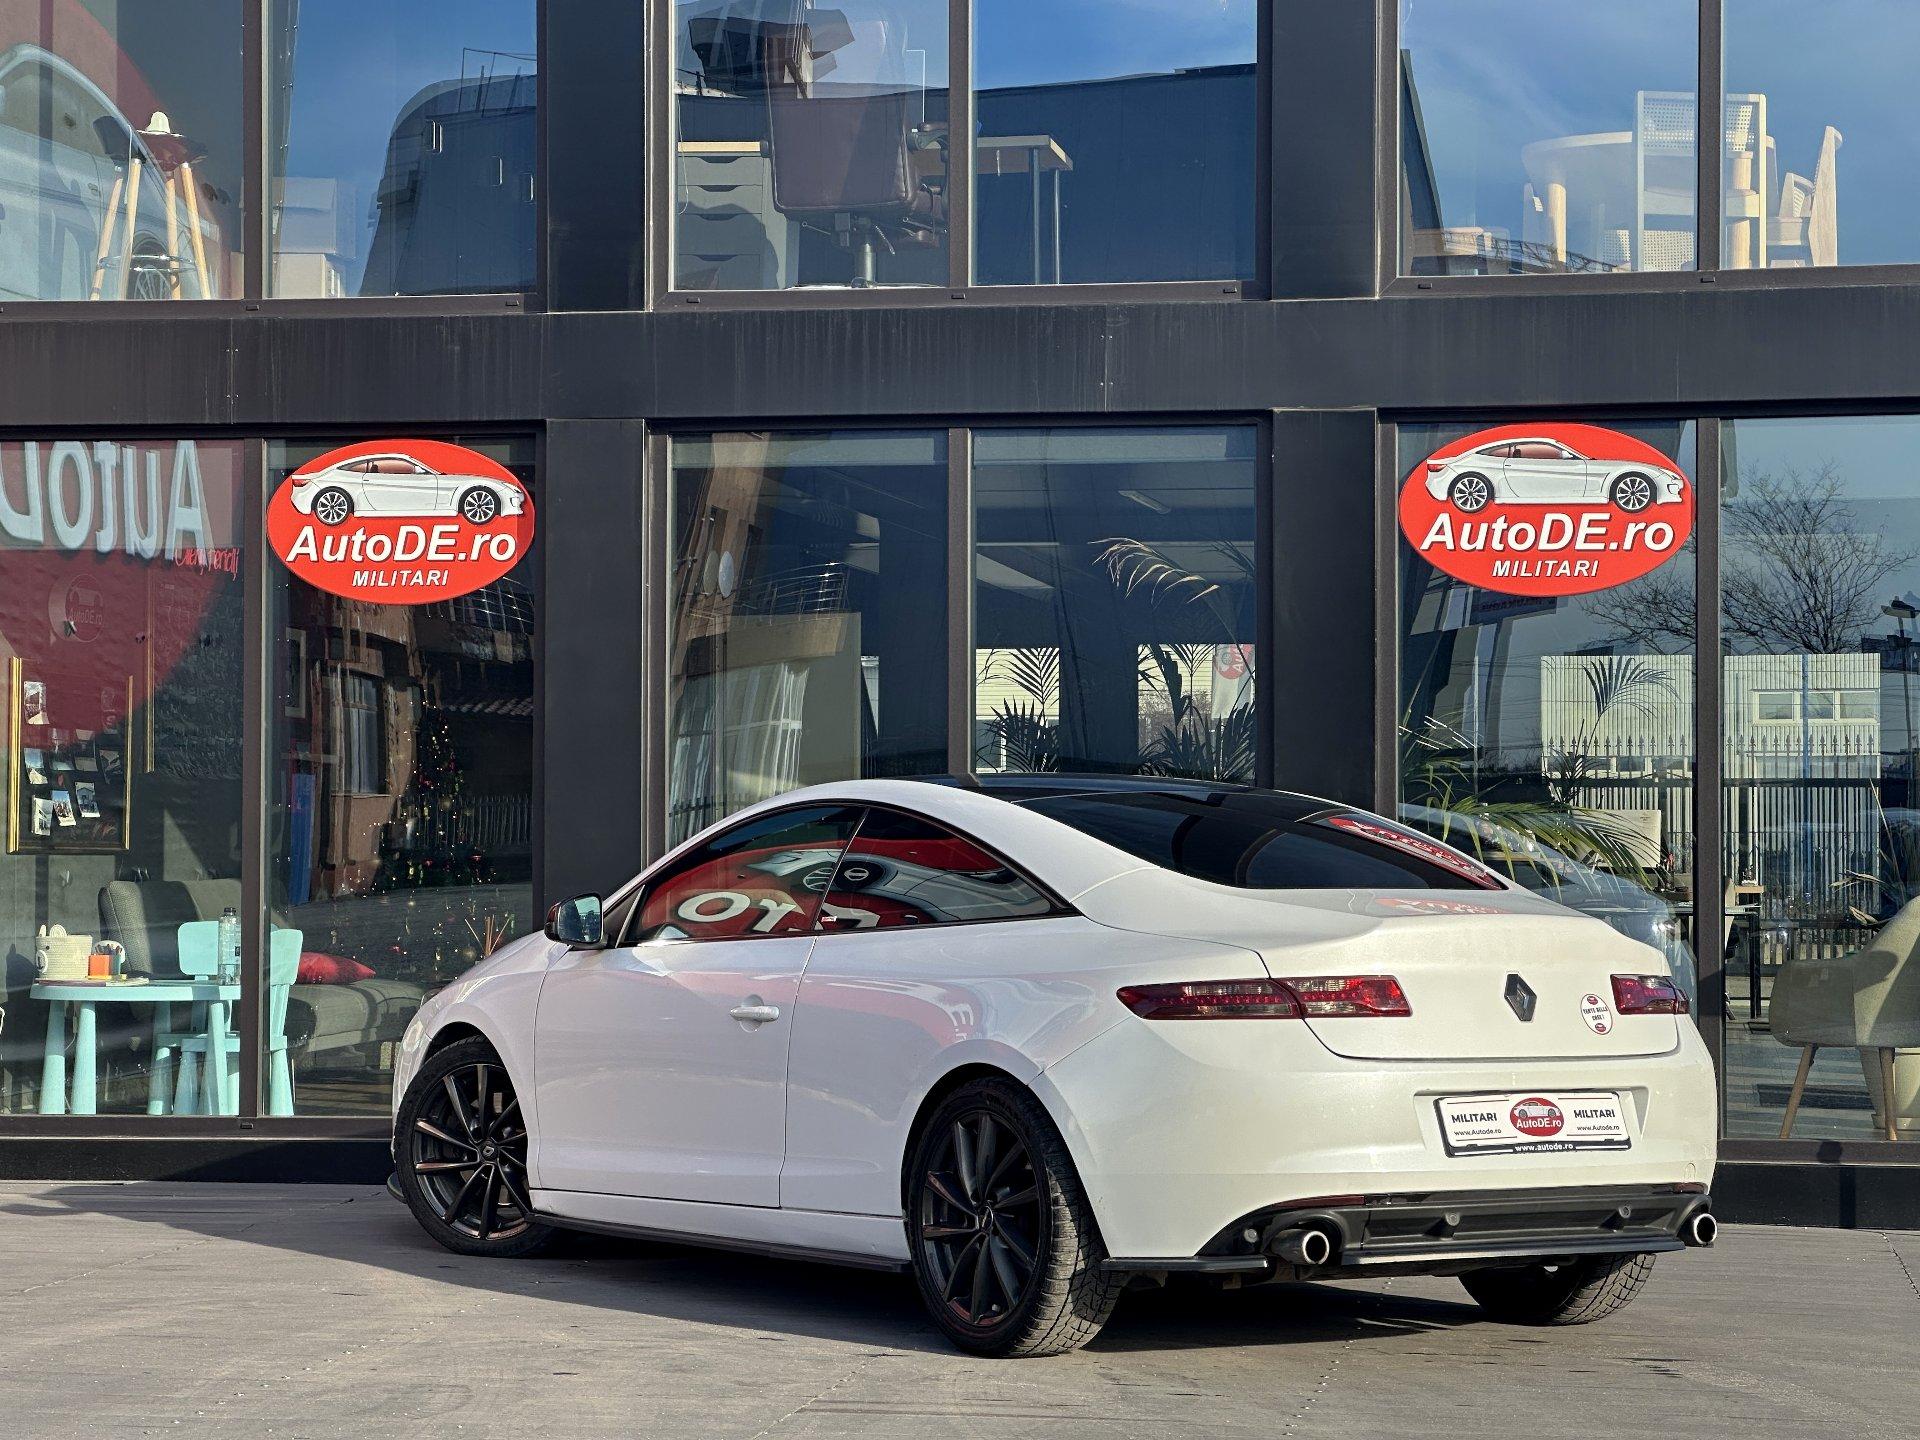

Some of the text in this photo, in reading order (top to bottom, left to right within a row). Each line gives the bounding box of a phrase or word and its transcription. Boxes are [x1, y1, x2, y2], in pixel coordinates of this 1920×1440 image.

[1420, 512, 1674, 551] AutoDE.ro
[286, 524, 517, 564] AutoDE.ro
[1492, 560, 1598, 577] MILITARI
[352, 569, 449, 587] MILITARI
[1450, 1112, 1498, 1124] MILITARI
[1573, 1109, 1616, 1119] MILITARI
[1516, 1117, 1563, 1130] AutoDE.ro
[1515, 1142, 1574, 1152] www.autode.ro
